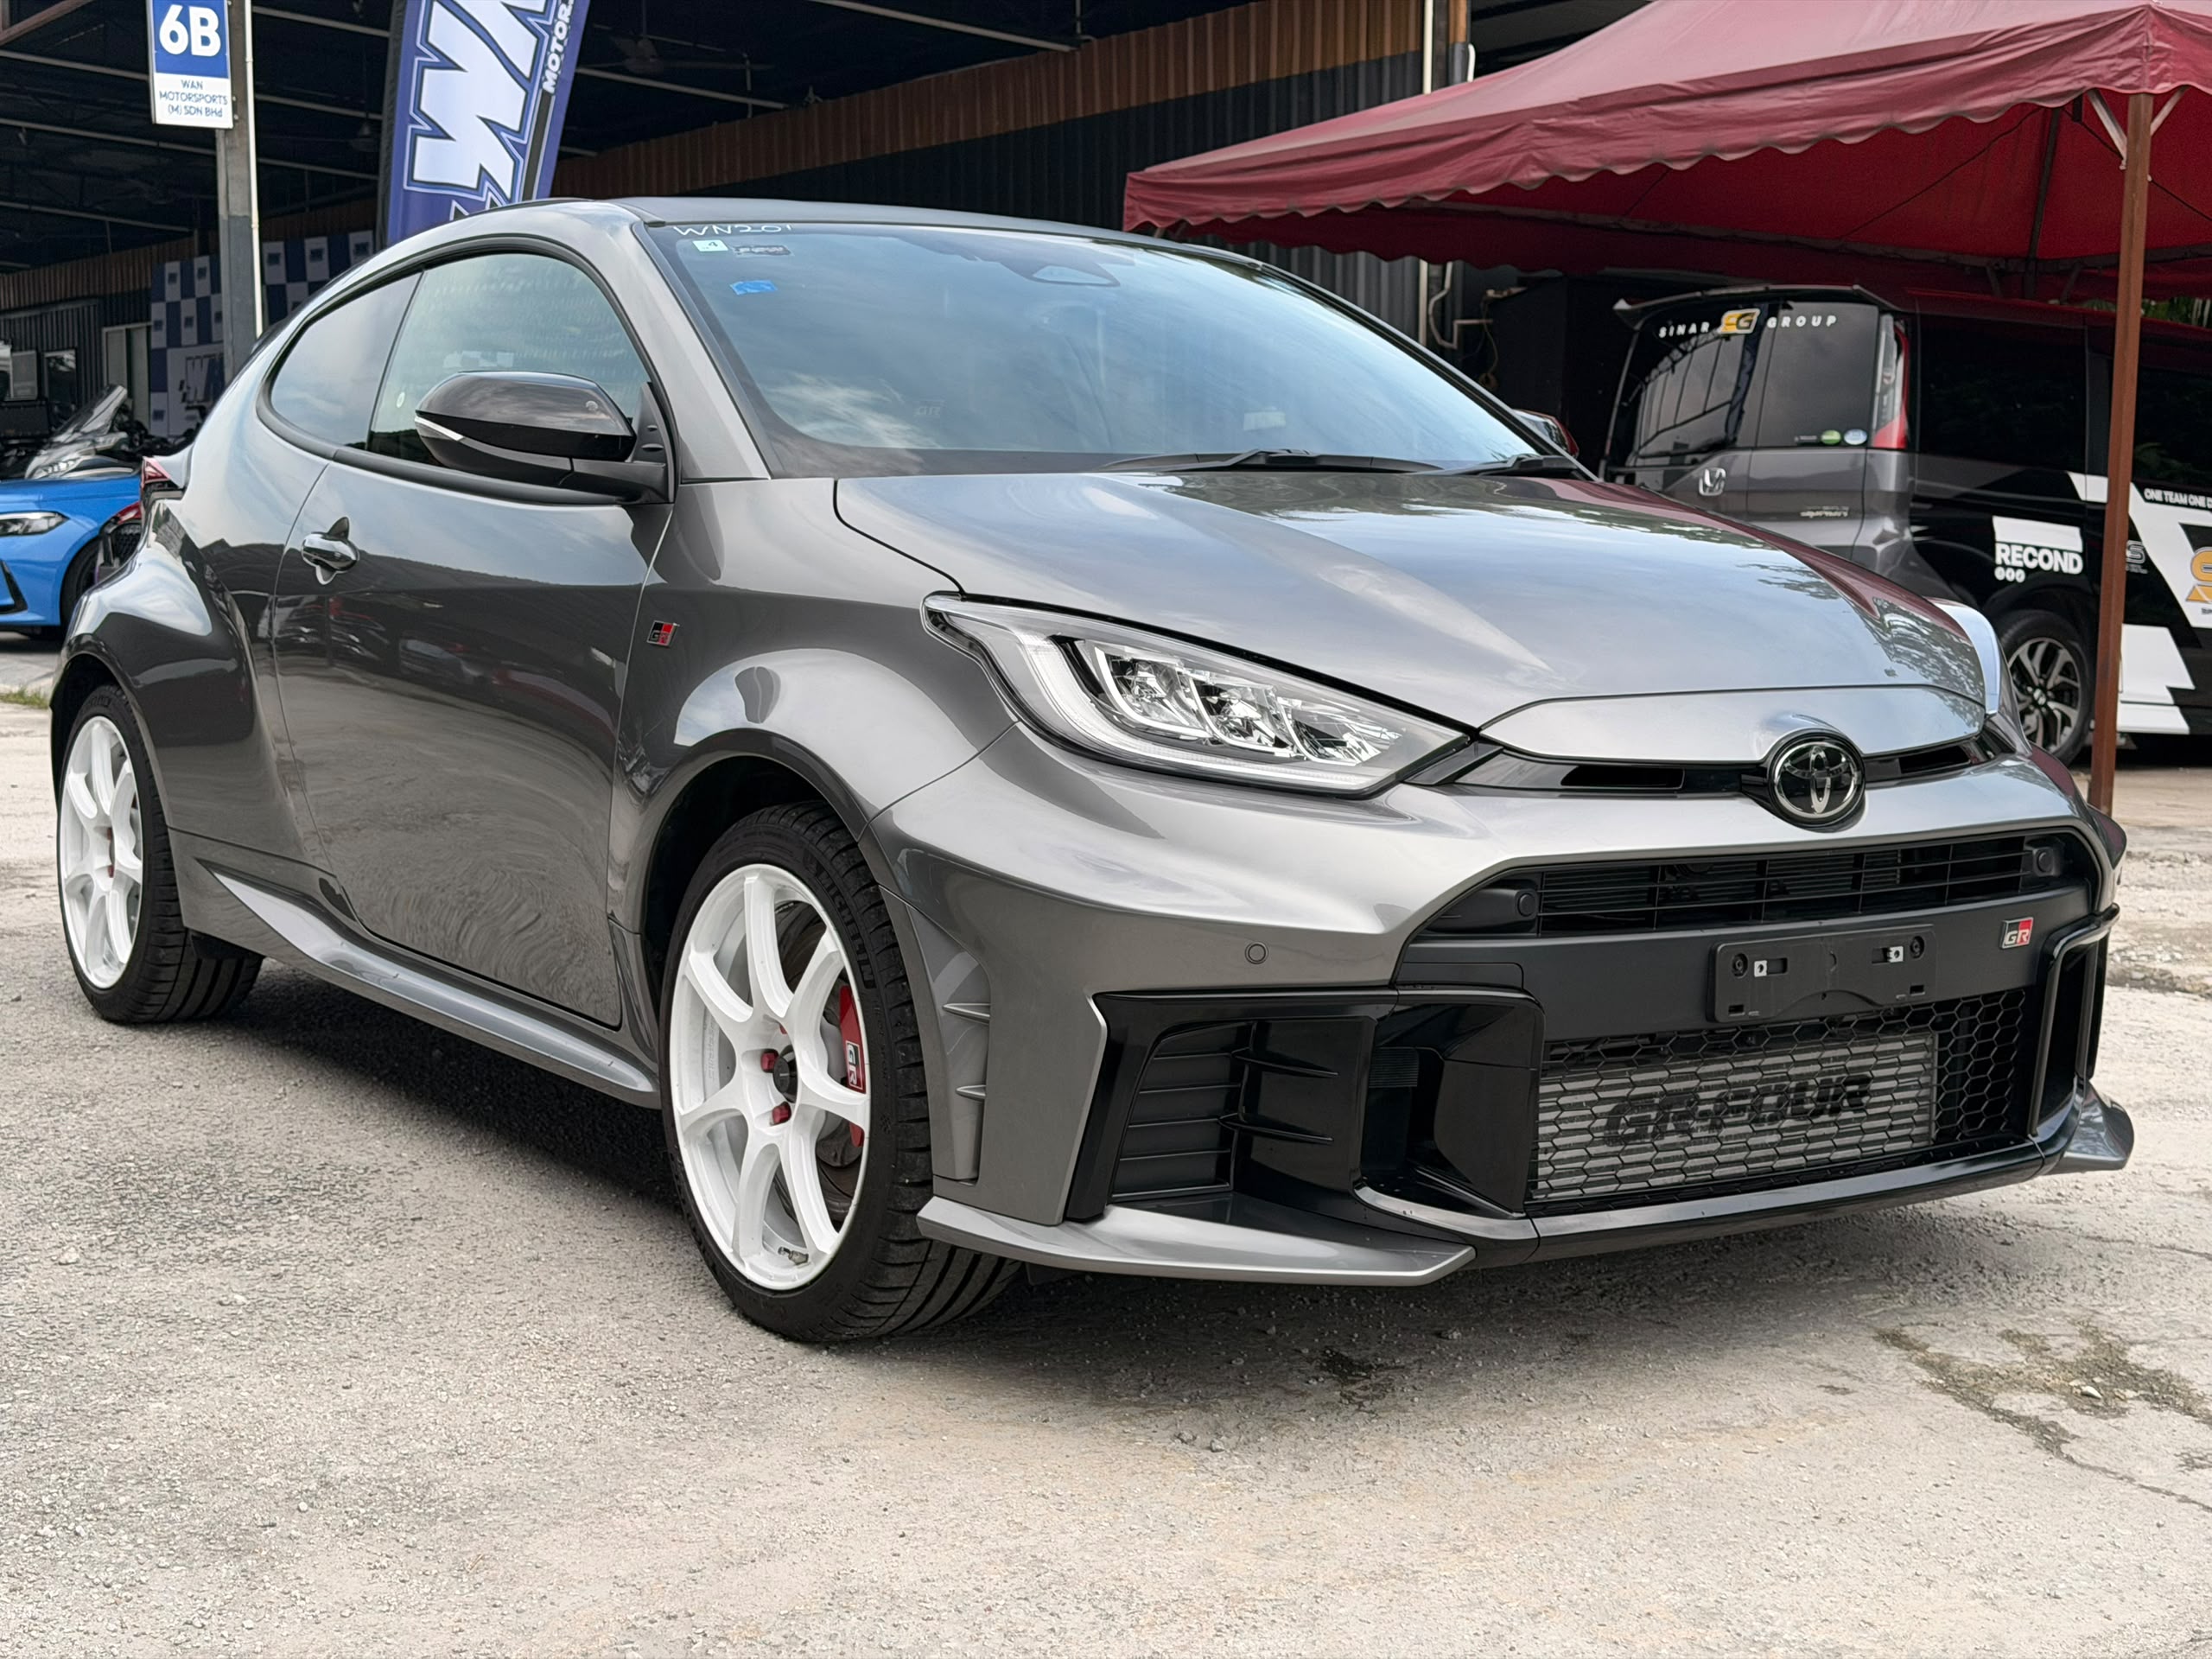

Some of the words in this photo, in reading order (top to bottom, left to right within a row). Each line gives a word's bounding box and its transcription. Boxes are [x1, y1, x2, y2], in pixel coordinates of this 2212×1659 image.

[159, 4, 221, 57] 6B
[542, 0, 575, 94] MOTOR
[181, 79, 203, 90] WAN
[159, 91, 228, 105] MOTORSPORTS
[168, 105, 182, 115] (M)
[183, 105, 202, 116] SDN
[1659, 321, 1710, 338] SINAR
[1766, 315, 1837, 328] GROUP
[2144, 487, 2163, 501] ONE
[2163, 490, 2188, 505] TEAM
[2188, 493, 2206, 508] ONE
[1994, 542, 2083, 575] RECOND
[2005, 929, 2031, 945] GR
[847, 1044, 857, 1085] GR
